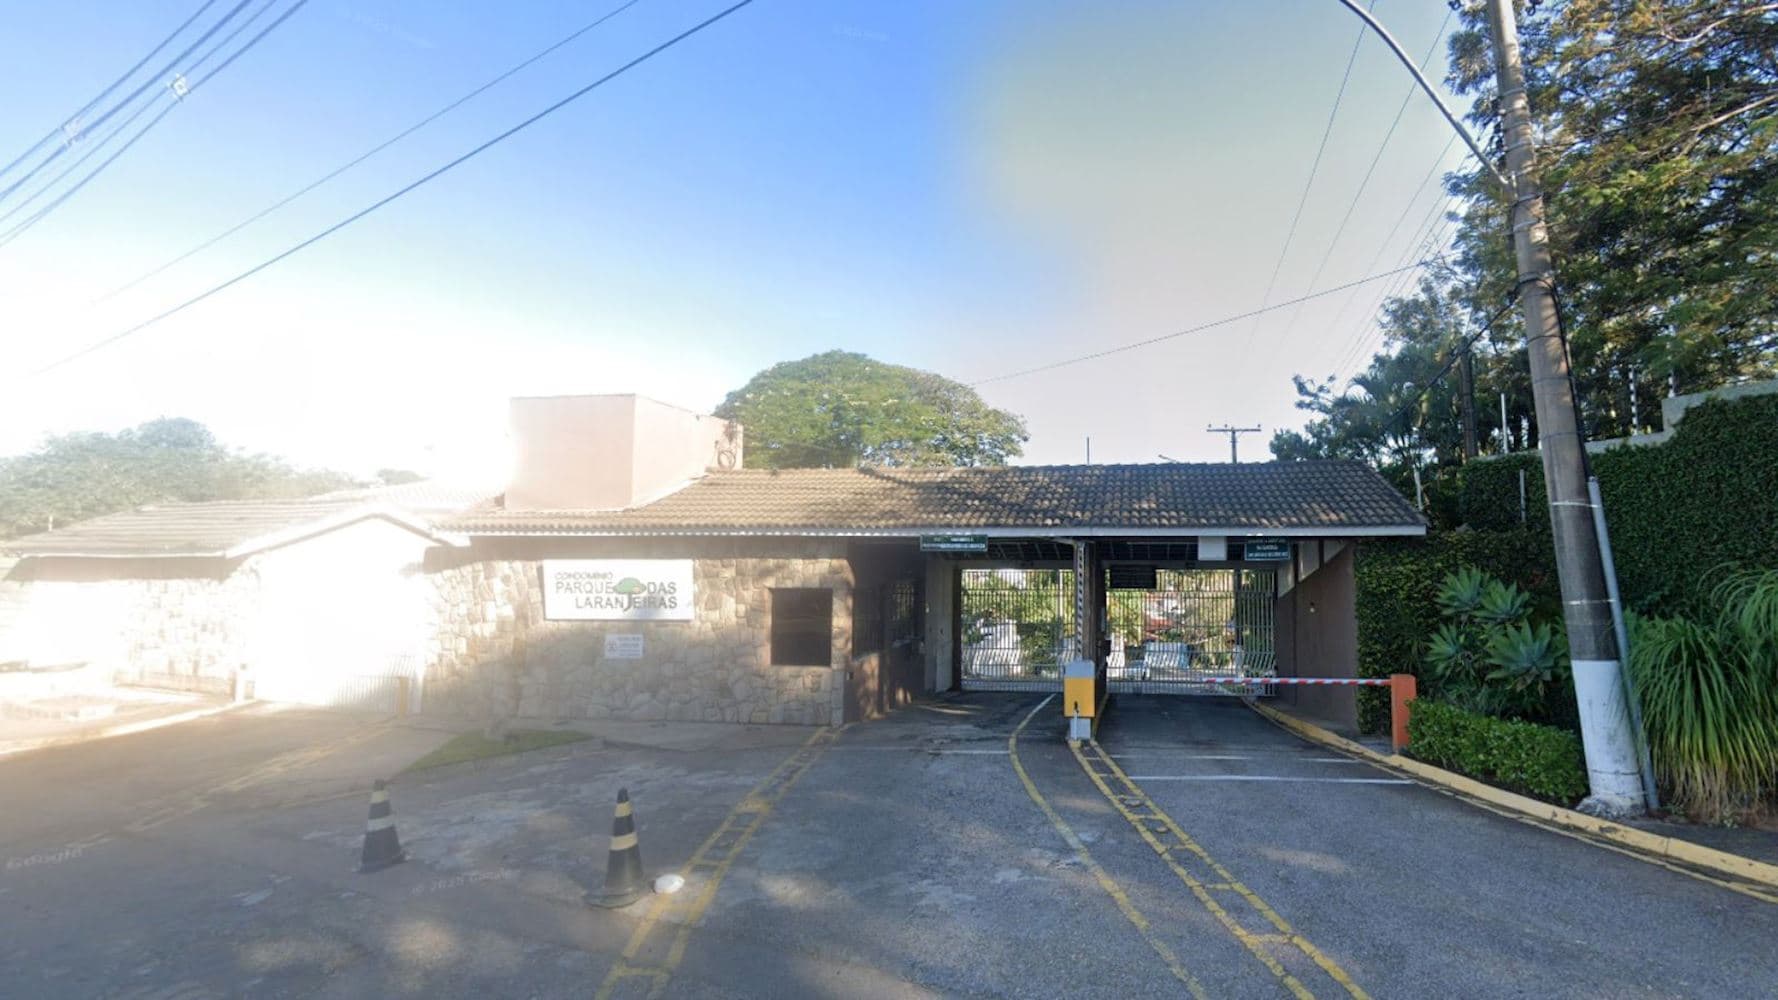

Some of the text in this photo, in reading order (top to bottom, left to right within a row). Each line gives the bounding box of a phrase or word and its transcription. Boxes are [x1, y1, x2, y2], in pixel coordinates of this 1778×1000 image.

[555, 581, 677, 594] PARQUE DAS
[575, 595, 678, 611] LARANJEIRAS
